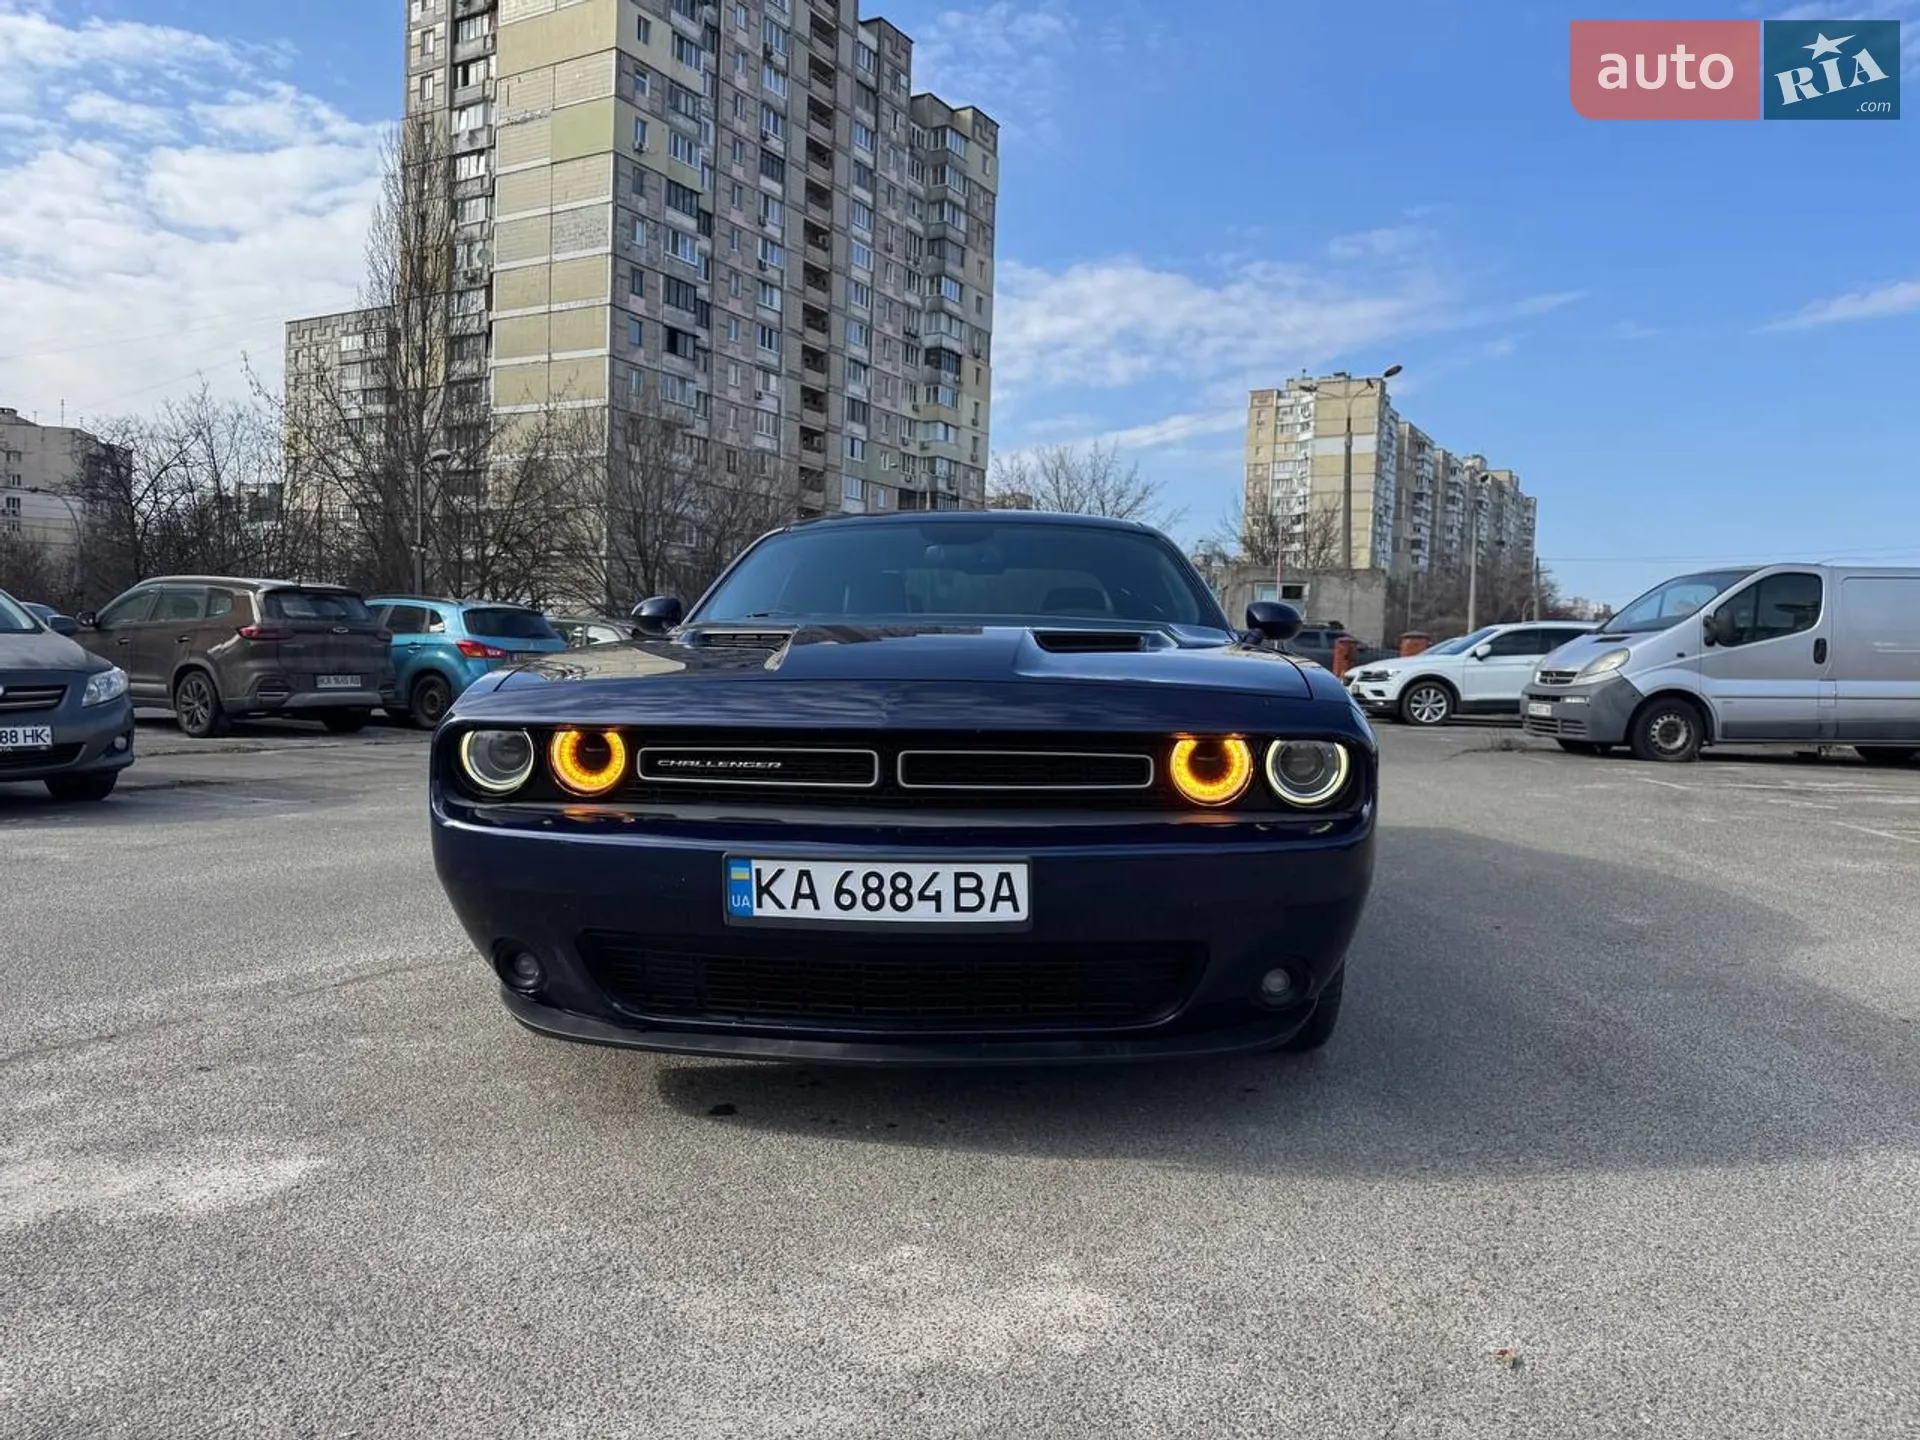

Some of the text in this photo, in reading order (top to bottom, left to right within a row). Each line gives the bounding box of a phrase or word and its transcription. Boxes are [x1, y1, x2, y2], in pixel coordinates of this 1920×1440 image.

[23, 729, 47, 743] HK
[657, 759, 782, 769] CHALLENGER
[754, 868, 1020, 913] KA 6884 BA
[732, 894, 751, 908] UA
